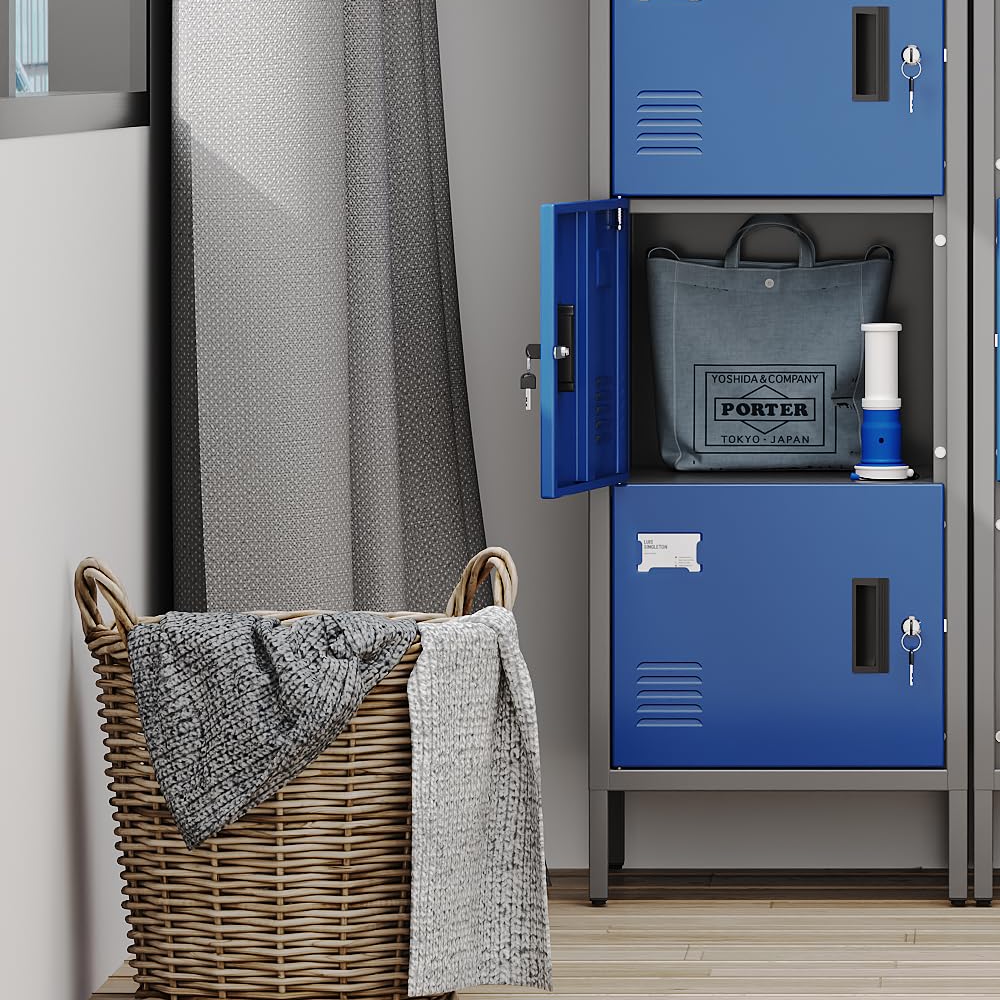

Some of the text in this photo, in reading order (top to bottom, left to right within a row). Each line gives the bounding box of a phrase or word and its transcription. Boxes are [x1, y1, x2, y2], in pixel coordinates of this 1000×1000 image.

[721, 403, 808, 416] PORTER
[721, 435, 810, 444] TOKYO JAPAN
